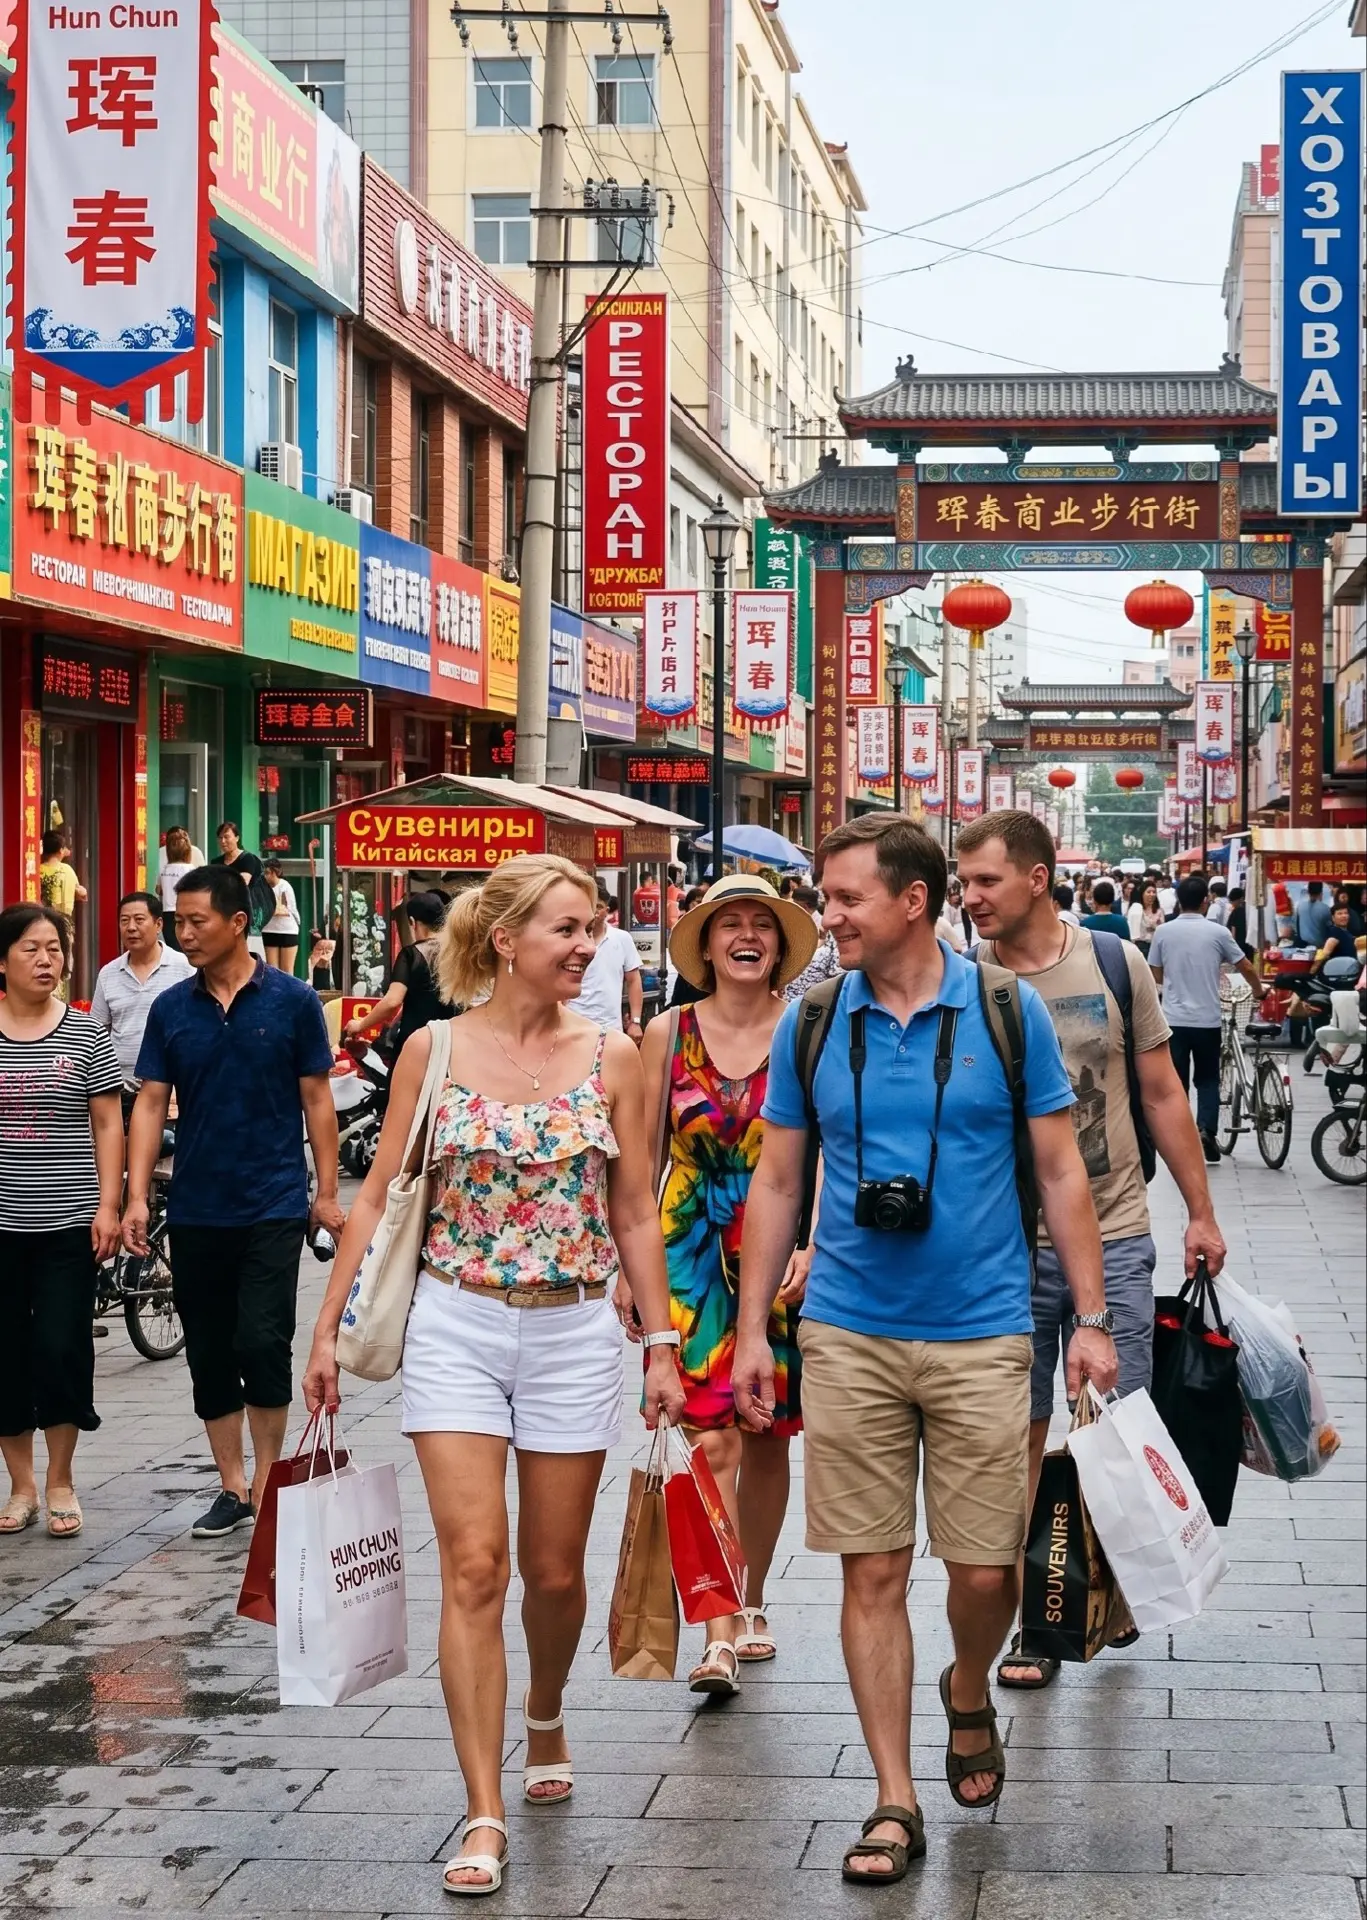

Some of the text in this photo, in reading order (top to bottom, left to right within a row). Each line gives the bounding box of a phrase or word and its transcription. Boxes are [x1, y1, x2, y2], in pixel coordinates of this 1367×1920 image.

[48, 5, 178, 29] Hun Chun
[66, 56, 158, 286] 珲春
[1293, 87, 1346, 499] ХОЗТОВАРЫ
[605, 322, 646, 559] РЕСТОРАН
[936, 493, 1200, 533] 珲春商业步行街
[31, 553, 86, 588] РЕСТОРАН
[250, 511, 359, 612] МАГАЗИН
[747, 621, 776, 690] 珲春
[349, 810, 534, 843] Сувениры
[353, 843, 477, 863] Китайская
[330, 1527, 398, 1569] HUN CHUN
[1046, 1503, 1069, 1623] SOUVENIRS
[335, 1552, 402, 1593] SHOPPING
